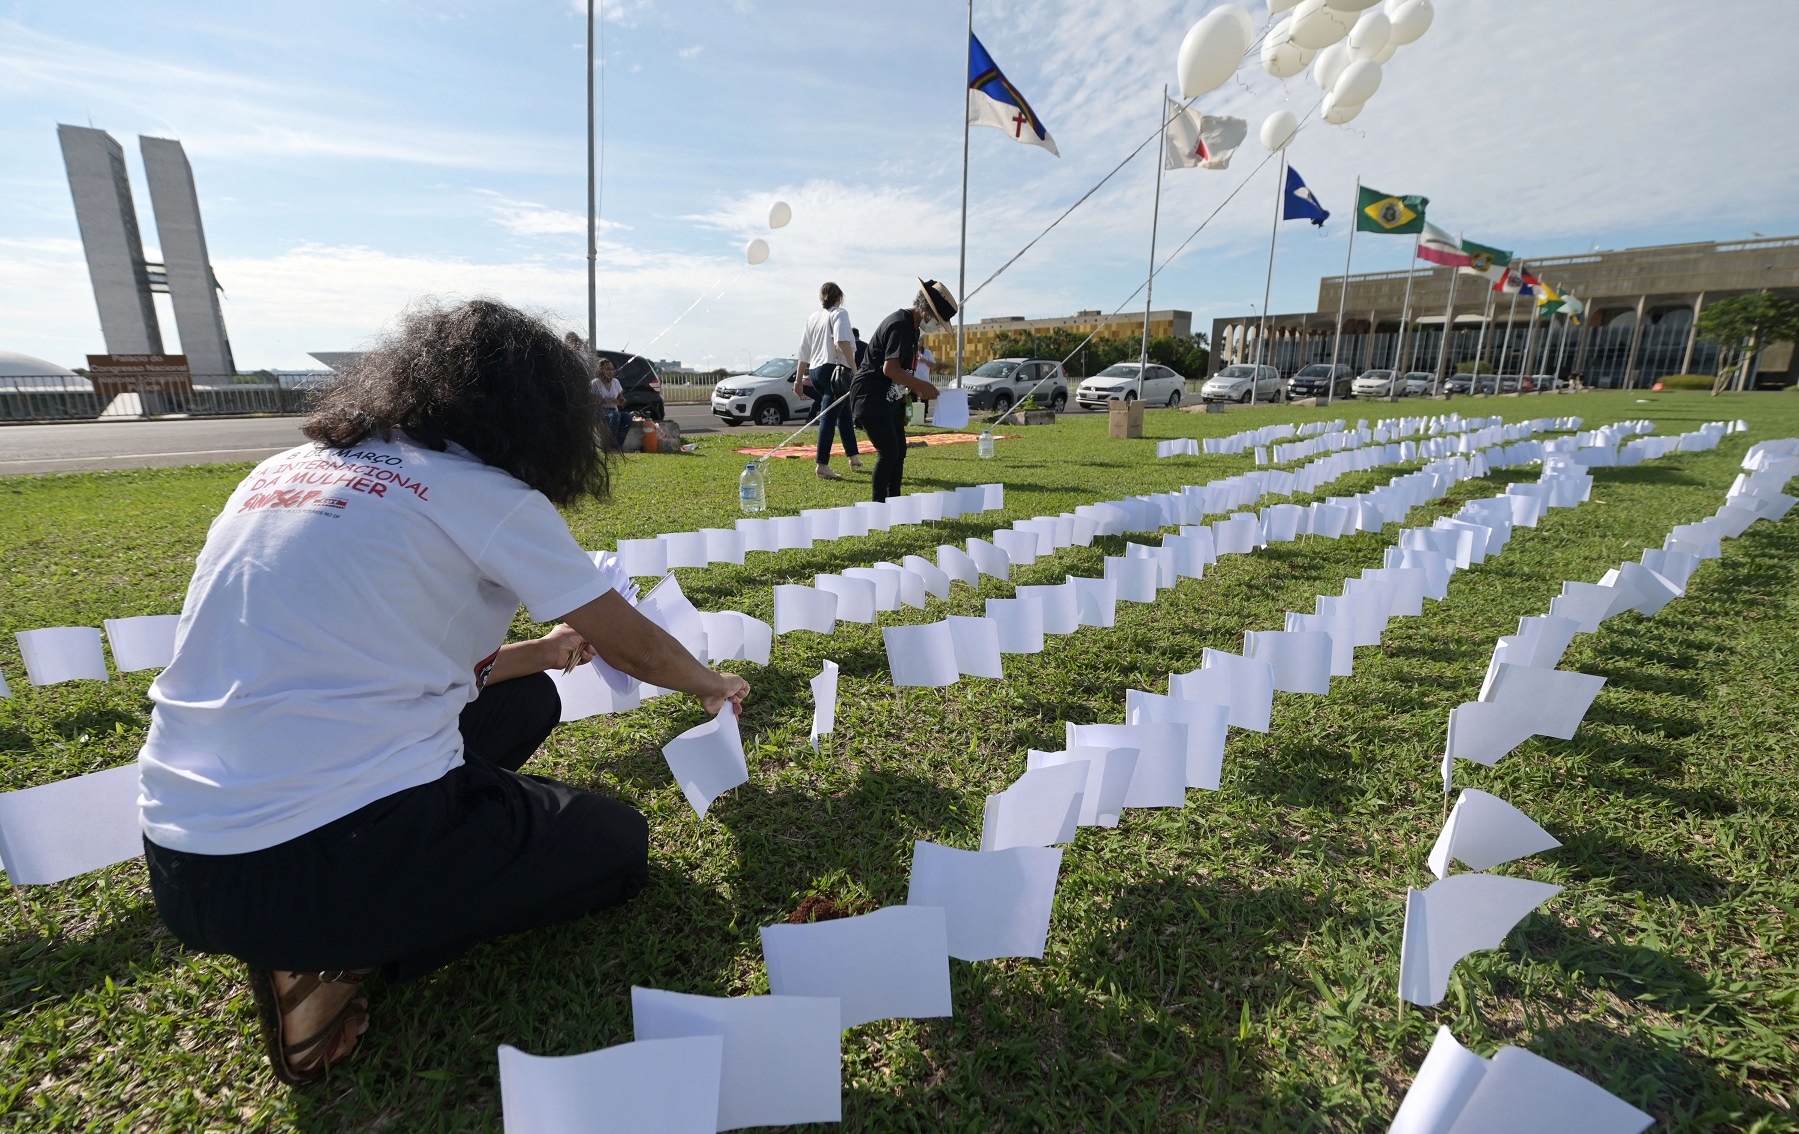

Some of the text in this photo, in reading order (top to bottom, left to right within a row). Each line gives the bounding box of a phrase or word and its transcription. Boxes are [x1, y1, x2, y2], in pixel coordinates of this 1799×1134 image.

[91, 364, 188, 373] Congresso Nacional
[250, 471, 387, 498] DA MULHER
[272, 459, 429, 501] INTERNACIONAL
